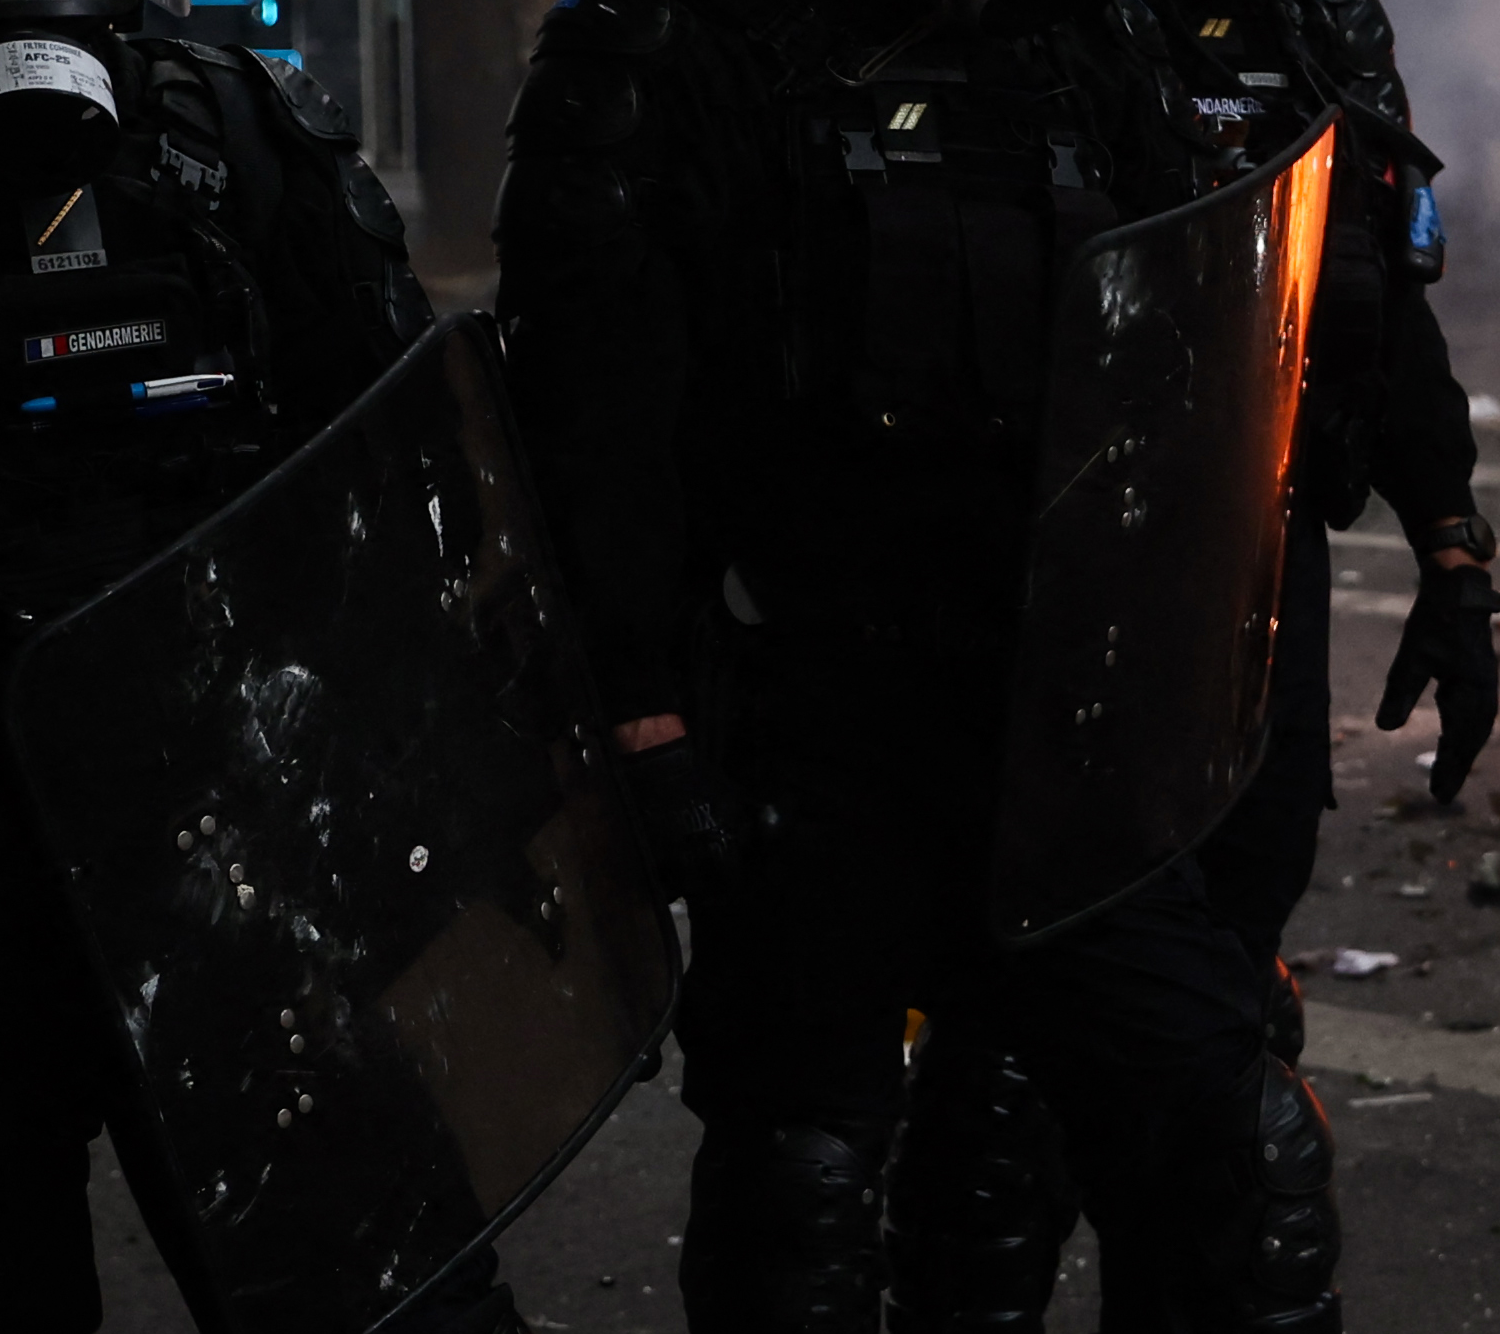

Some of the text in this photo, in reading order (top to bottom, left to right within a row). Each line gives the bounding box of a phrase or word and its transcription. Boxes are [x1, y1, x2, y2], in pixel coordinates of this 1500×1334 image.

[23, 42, 48, 51] FILTRE
[24, 52, 71, 66] AFC-25
[38, 252, 101, 271] 6121102
[68, 322, 163, 352] GENDARMERIE
